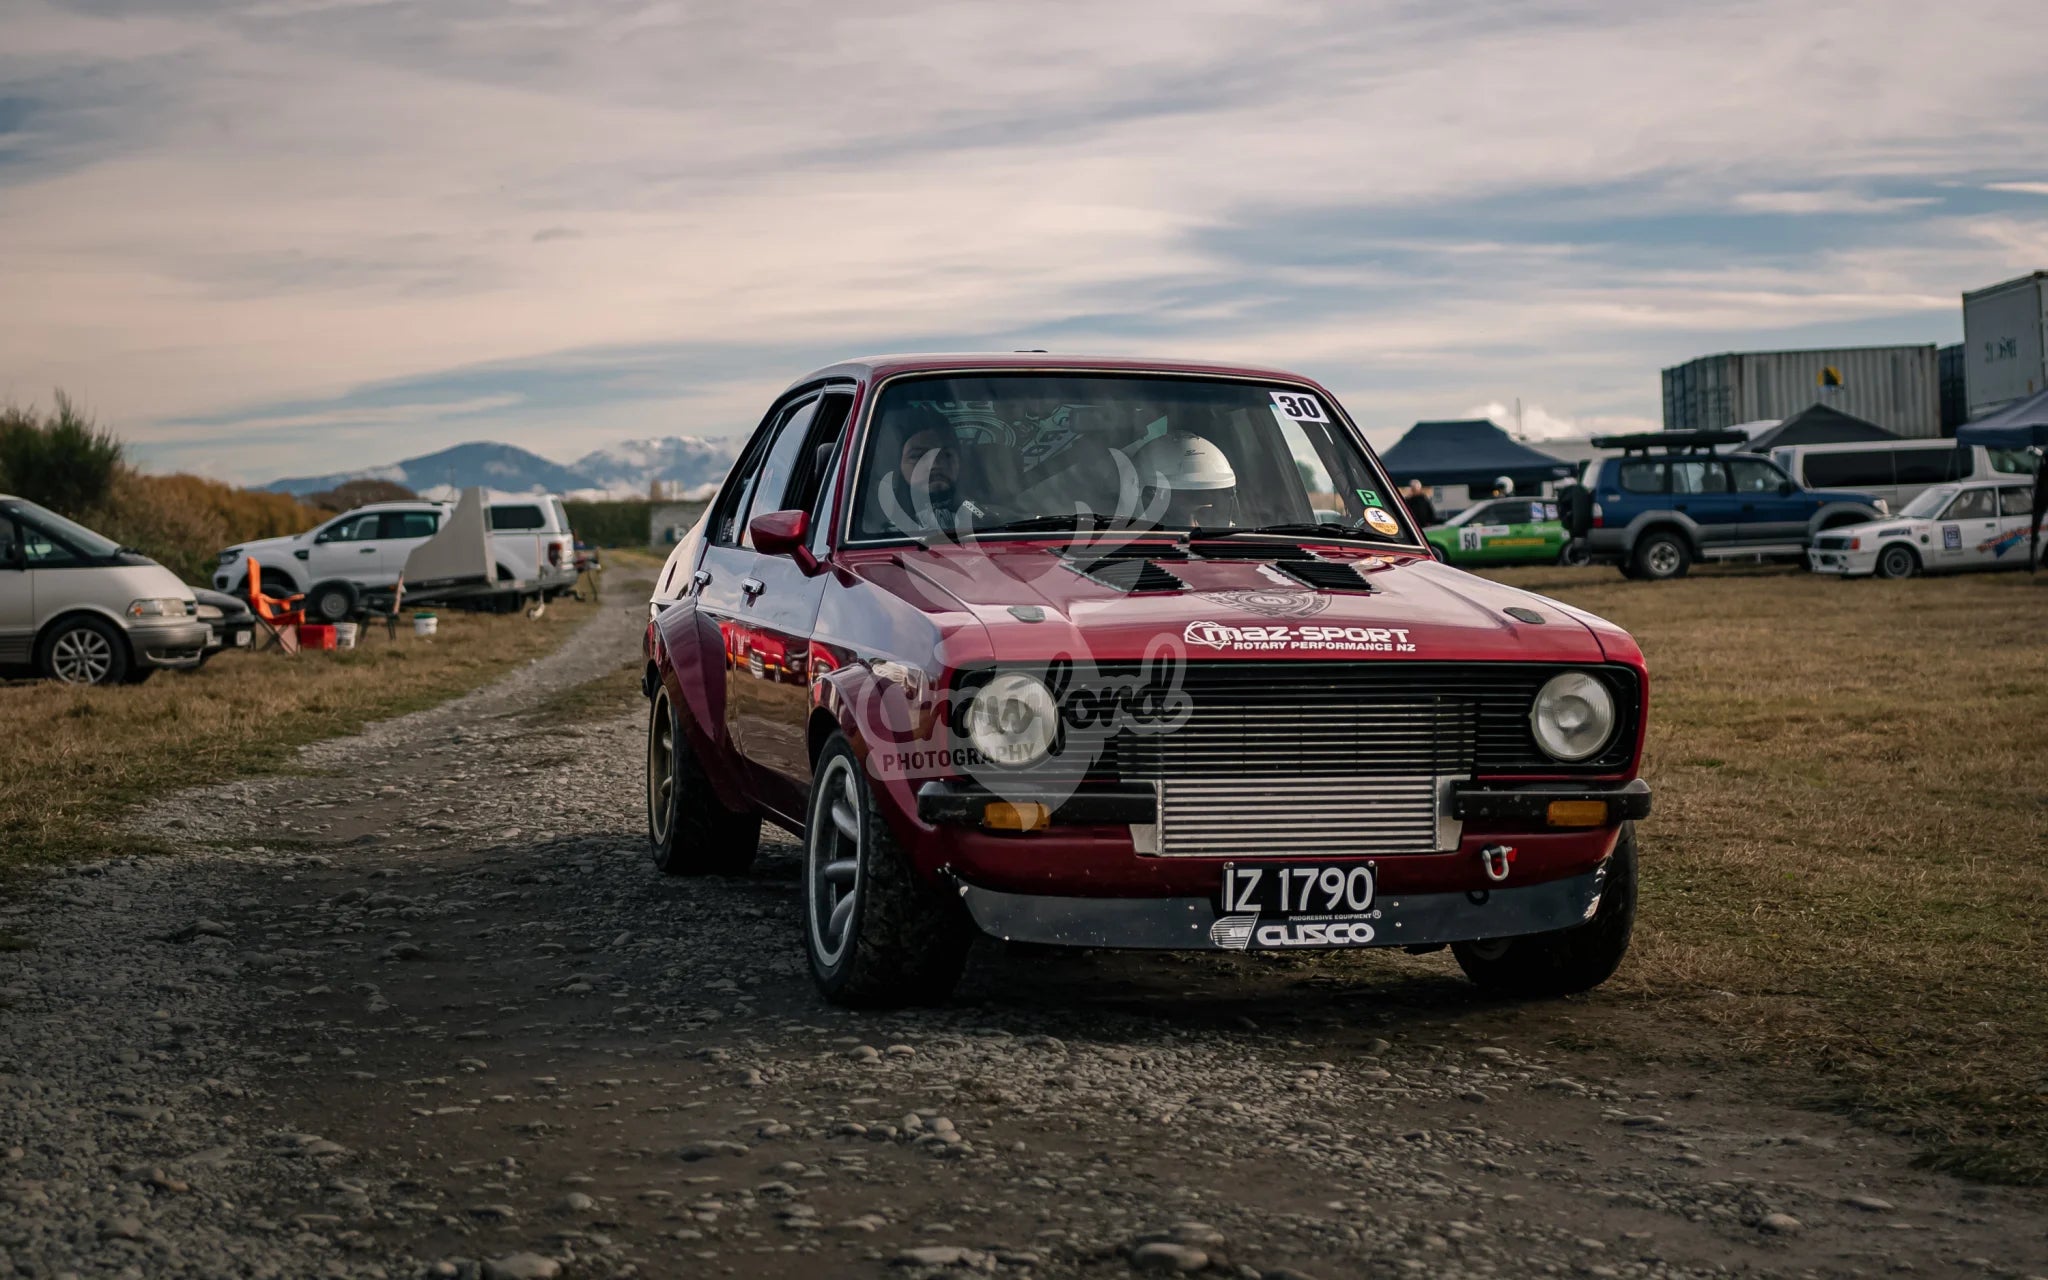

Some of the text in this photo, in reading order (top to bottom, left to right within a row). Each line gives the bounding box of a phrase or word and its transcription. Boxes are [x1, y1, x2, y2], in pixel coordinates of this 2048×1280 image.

[1278, 395, 1321, 418] 30
[1360, 491, 1375, 504] P
[1463, 532, 1478, 550] 50
[1233, 641, 1417, 652] ROTARY PERFORMANCE NZ
[1225, 867, 1374, 912] IZ 1790
[1256, 922, 1375, 946] CUSCO
